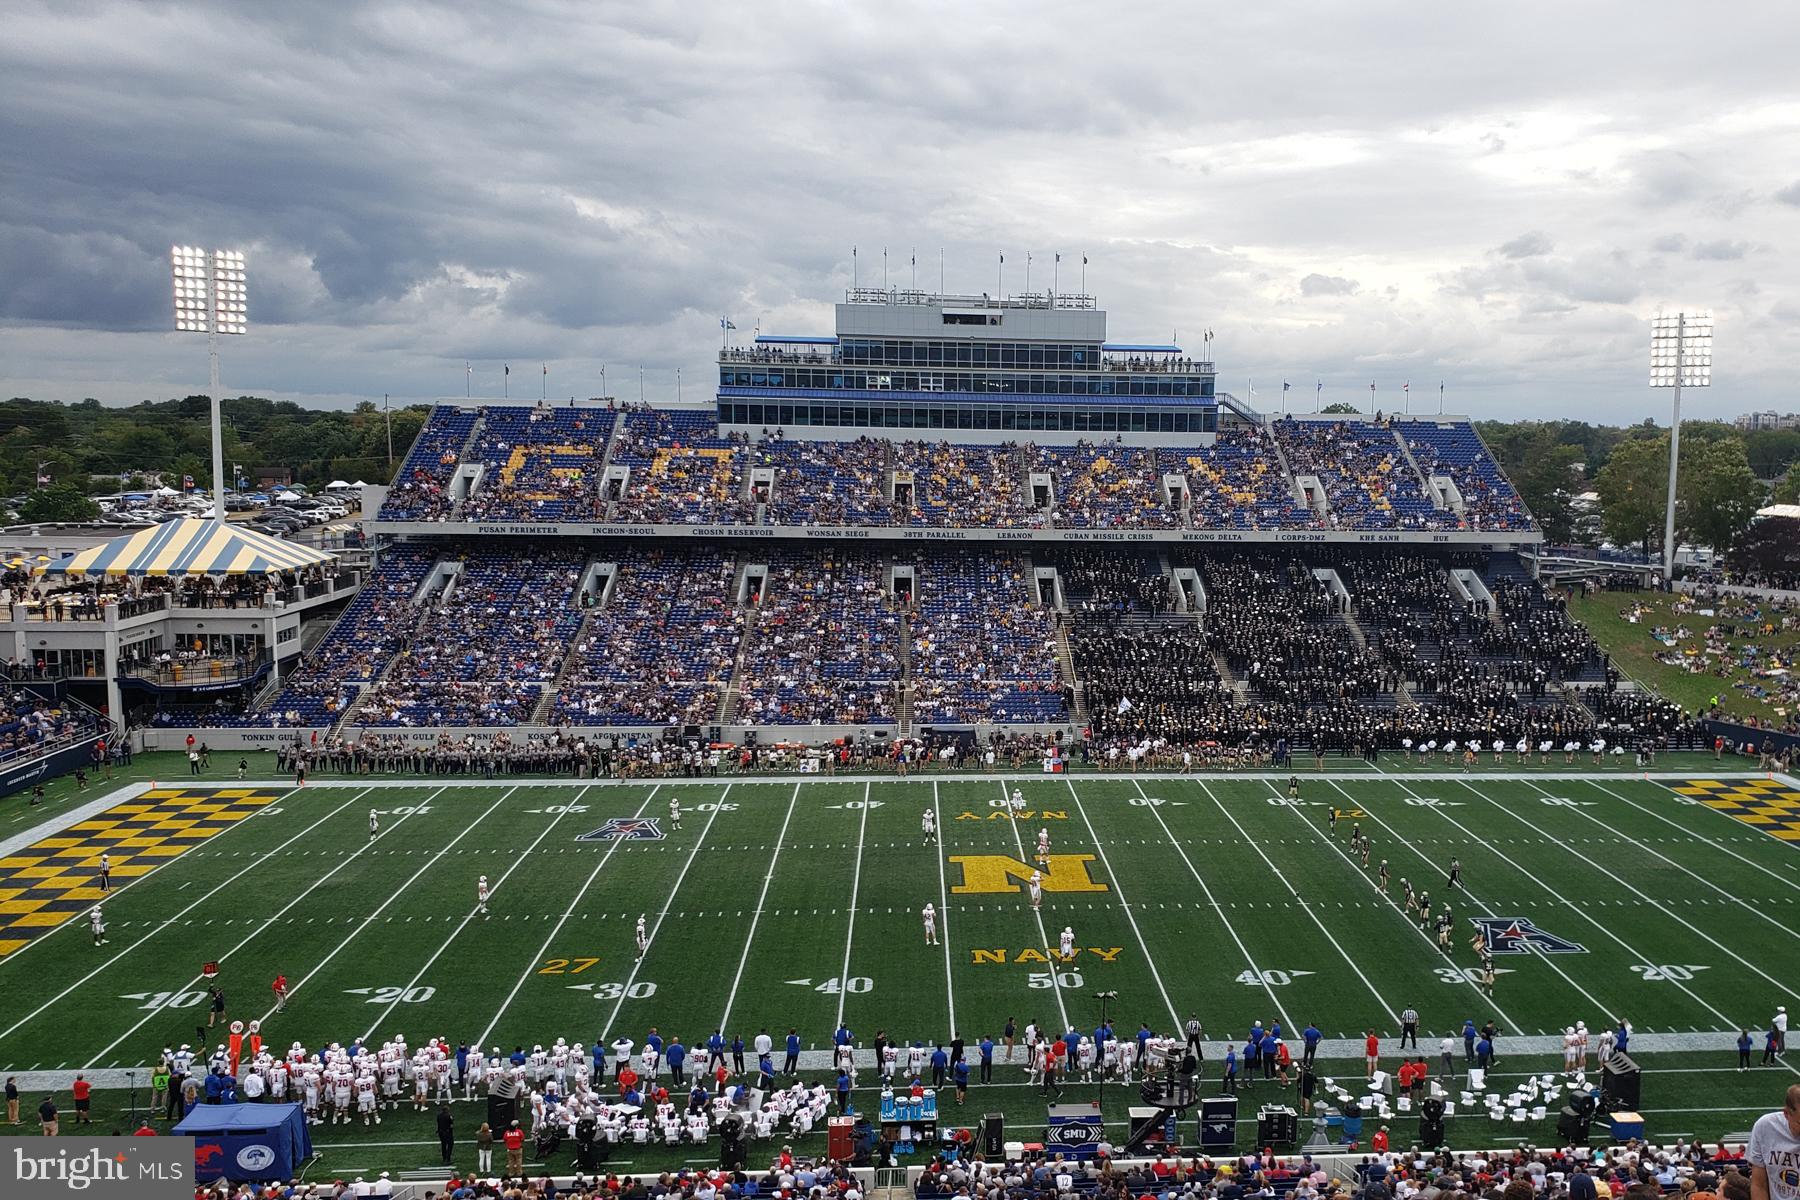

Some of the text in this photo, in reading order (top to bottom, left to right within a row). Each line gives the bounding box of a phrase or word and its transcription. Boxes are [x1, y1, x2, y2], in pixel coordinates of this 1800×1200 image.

[845, 801, 886, 810] 40
[1128, 798, 1167, 806] 40
[1540, 798, 1578, 806] 10
[391, 806, 436, 815] 10
[545, 805, 590, 814] 20
[697, 803, 740, 812] 30
[955, 811, 1068, 820] NAVY
[948, 854, 1111, 894] N
[971, 948, 1123, 964] NAVY
[538, 958, 600, 974] 27
[1236, 969, 1292, 986] 40
[1433, 968, 1486, 983] 30
[1629, 965, 1696, 981] 20
[1028, 973, 1084, 988] 50
[814, 977, 874, 994] 40
[365, 986, 436, 1004] 20
[593, 982, 657, 999] 30
[137, 991, 209, 1009] 10
[912, 1052, 920, 1060] 11
[472, 1060, 480, 1068] 14
[537, 1058, 544, 1066] 11
[338, 1079, 348, 1087] 70
[718, 1101, 727, 1109] 24
[1064, 1129, 1086, 1139] SMU
[1061, 1177, 1068, 1186] 12
